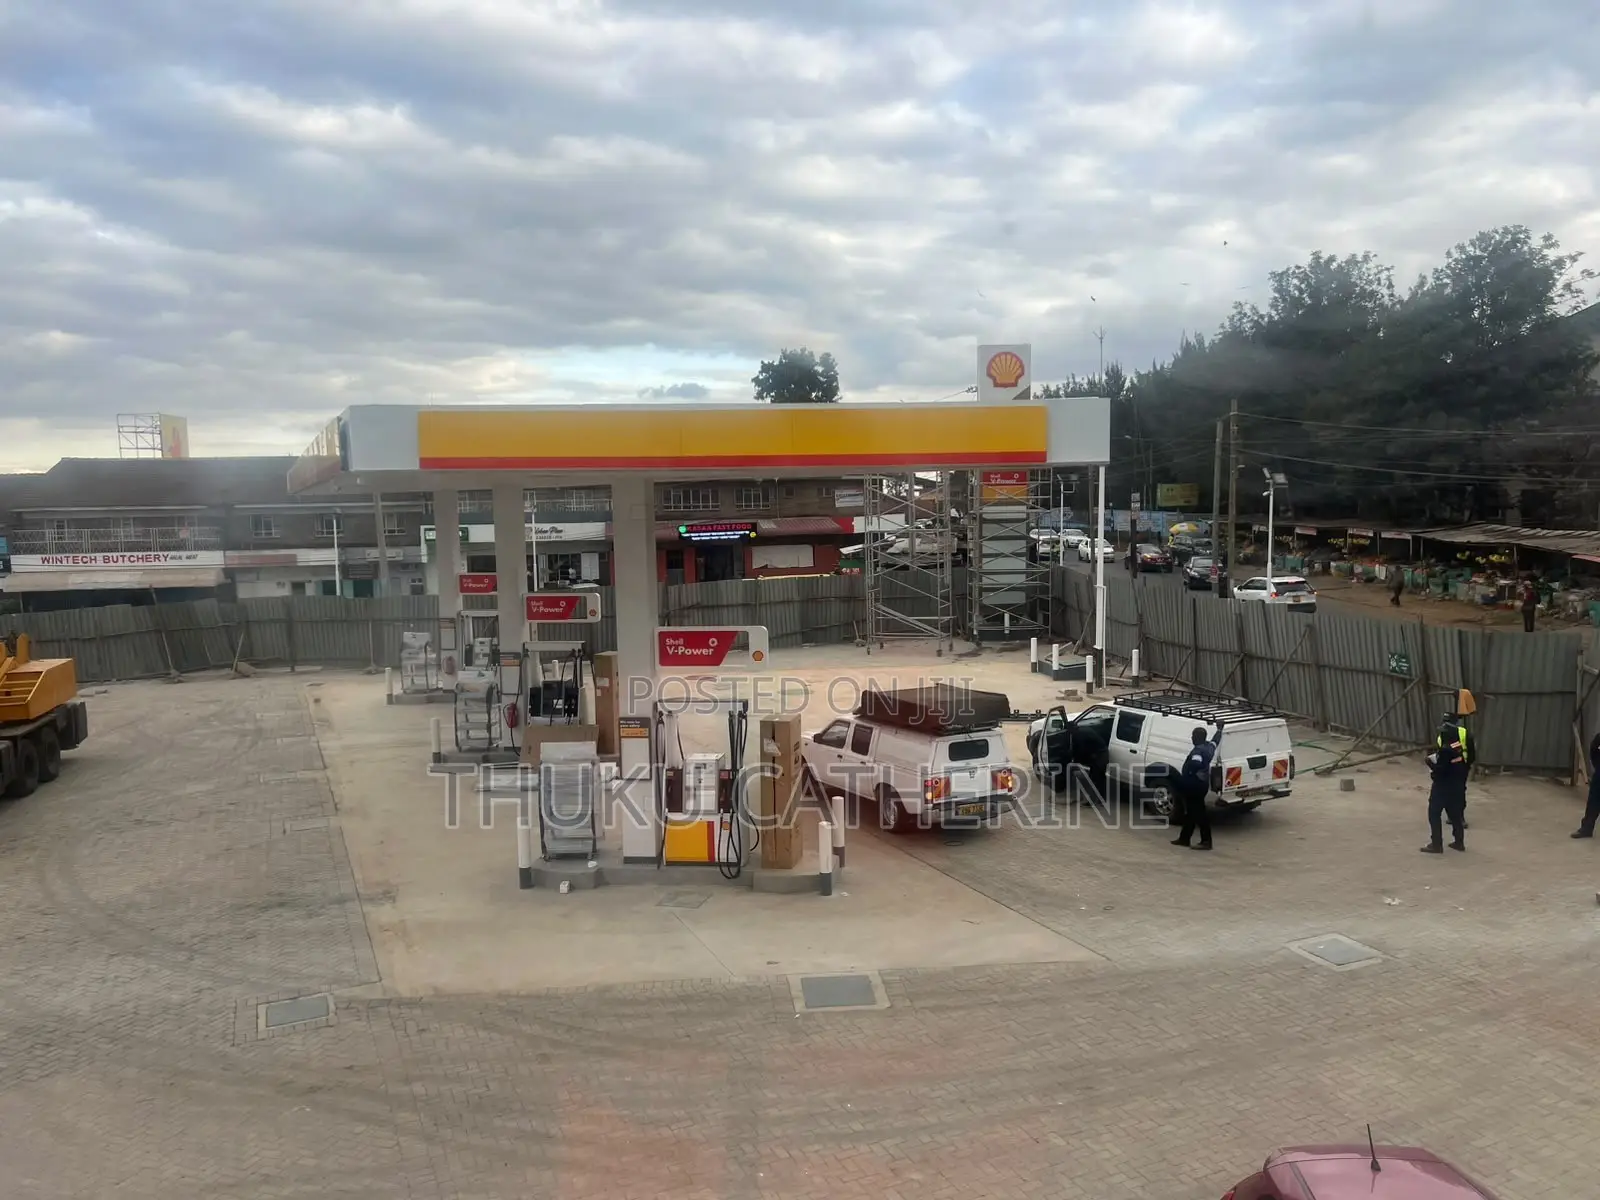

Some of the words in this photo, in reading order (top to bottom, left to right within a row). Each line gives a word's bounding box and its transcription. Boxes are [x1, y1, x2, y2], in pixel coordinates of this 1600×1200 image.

[41, 555, 98, 565] WINTECH
[102, 553, 170, 564] BUTCHERY
[665, 637, 684, 646] Shell
[666, 646, 714, 656] V-Power
